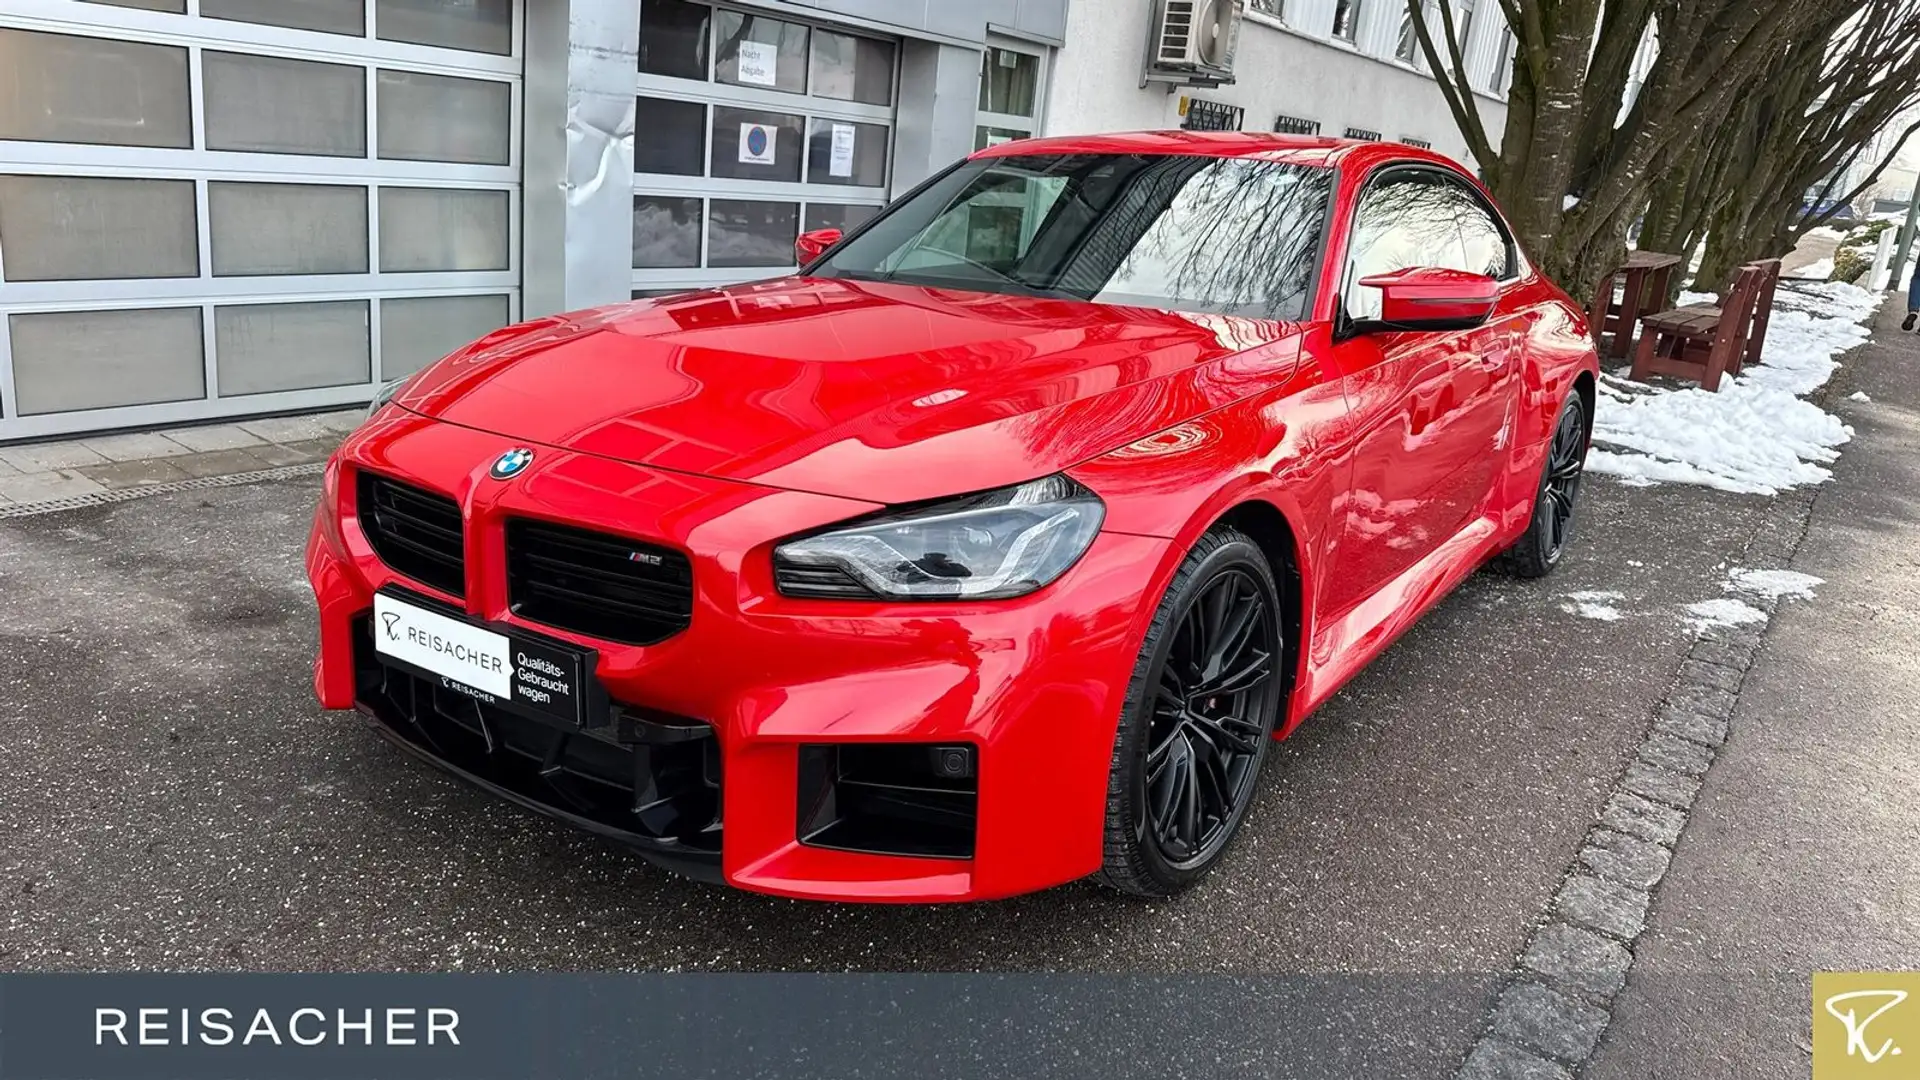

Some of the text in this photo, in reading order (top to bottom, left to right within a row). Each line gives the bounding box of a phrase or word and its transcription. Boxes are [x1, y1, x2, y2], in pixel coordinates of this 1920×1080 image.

[408, 626, 503, 674] REISACHER
[517, 652, 565, 677] Qualitäts-
[451, 681, 495, 704] REISACHER
[517, 668, 569, 695] Gebraucht
[518, 685, 551, 703] wagen
